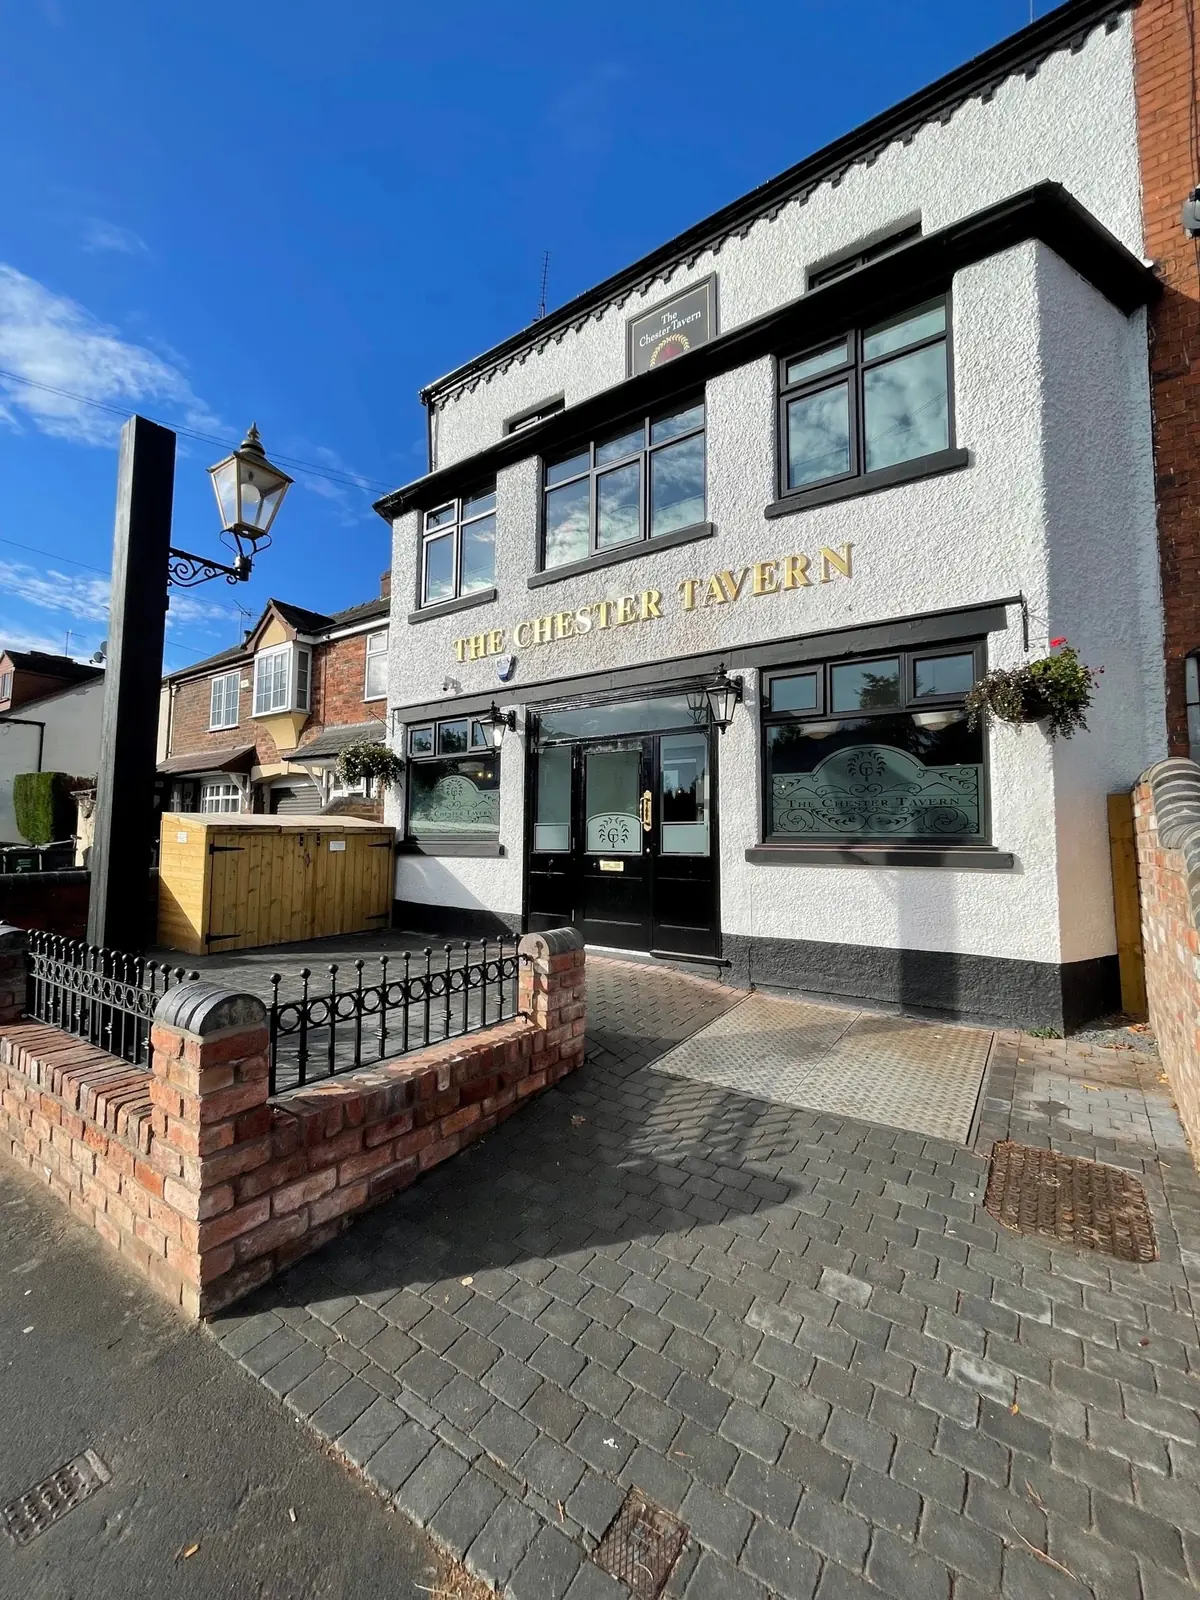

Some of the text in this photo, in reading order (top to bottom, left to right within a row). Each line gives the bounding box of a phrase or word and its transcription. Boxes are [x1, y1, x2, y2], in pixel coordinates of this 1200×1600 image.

[639, 310, 701, 347] Chester Tavern
[661, 312, 678, 325] The
[453, 542, 855, 662] THE CHESTER TAVERN
